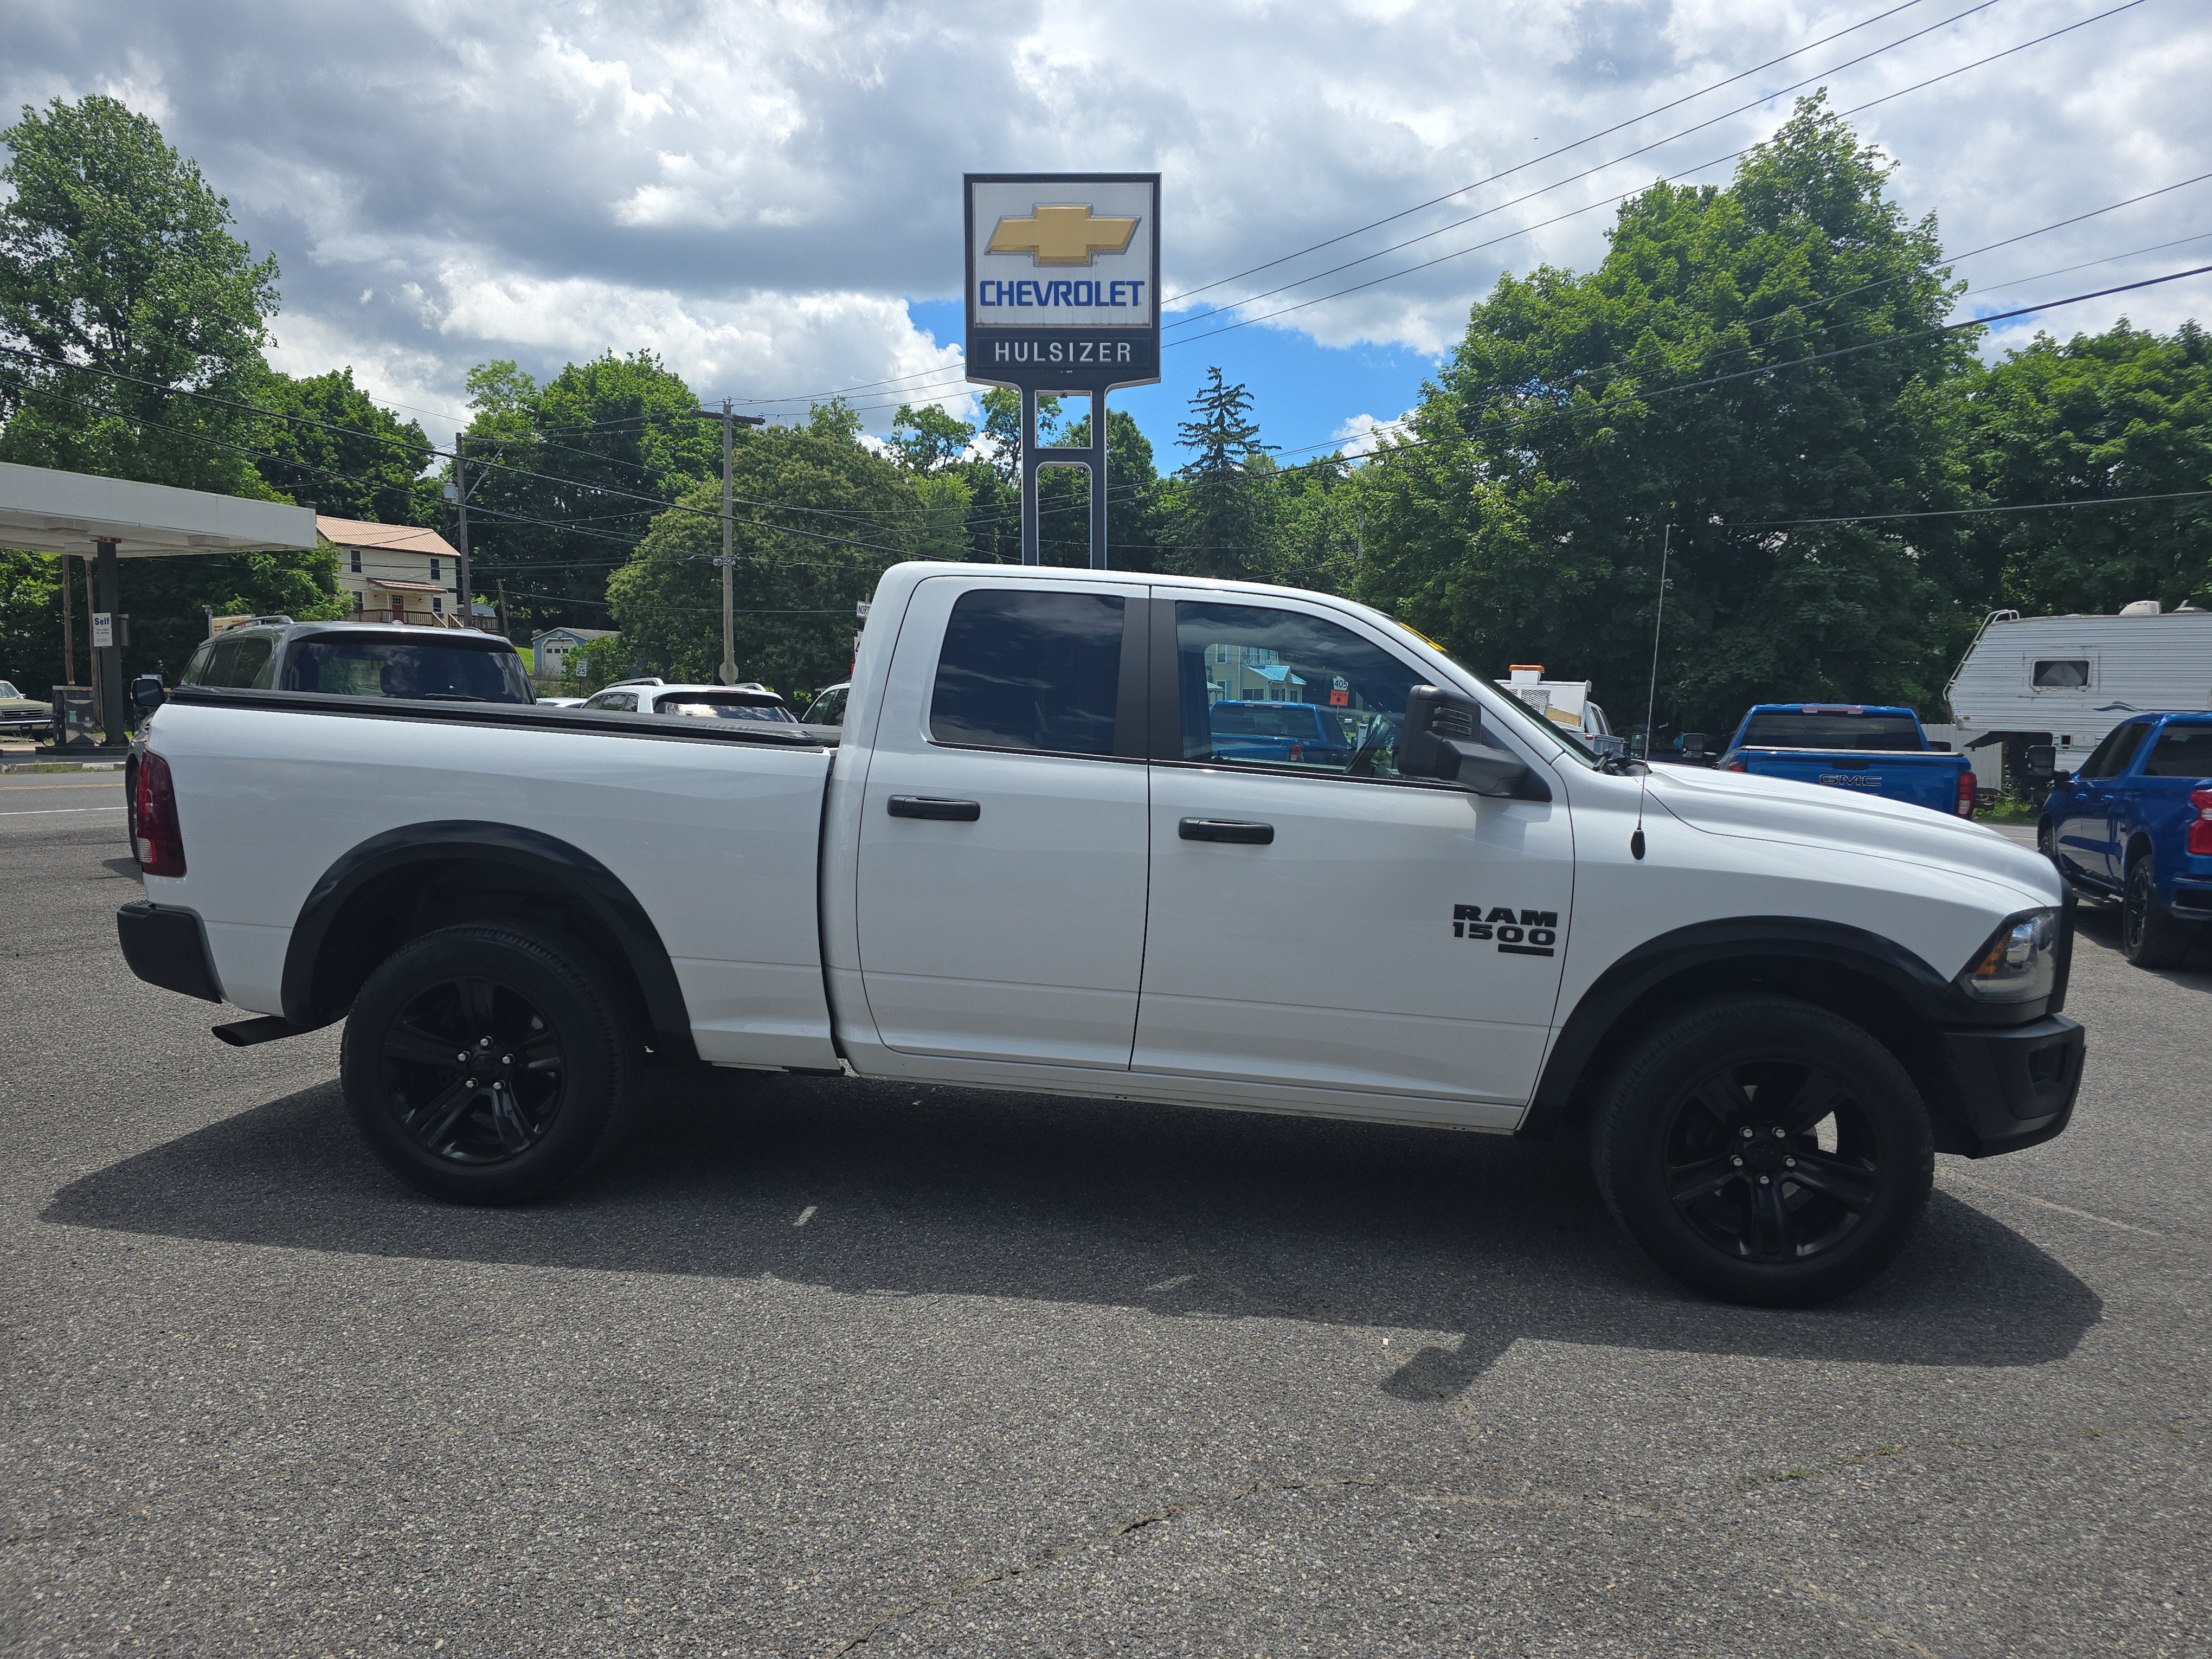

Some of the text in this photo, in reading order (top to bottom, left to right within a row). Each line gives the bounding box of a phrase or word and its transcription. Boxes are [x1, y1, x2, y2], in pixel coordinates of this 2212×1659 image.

[980, 280, 1145, 306] CHEVROLET
[995, 342, 1131, 362] HULSIZER
[858, 604, 871, 615] NORT
[94, 617, 110, 625] Self
[1334, 680, 1347, 689] 405
[1819, 774, 1882, 787] GMC
[1454, 904, 1558, 928] RAM
[1452, 922, 1555, 946] 1500
